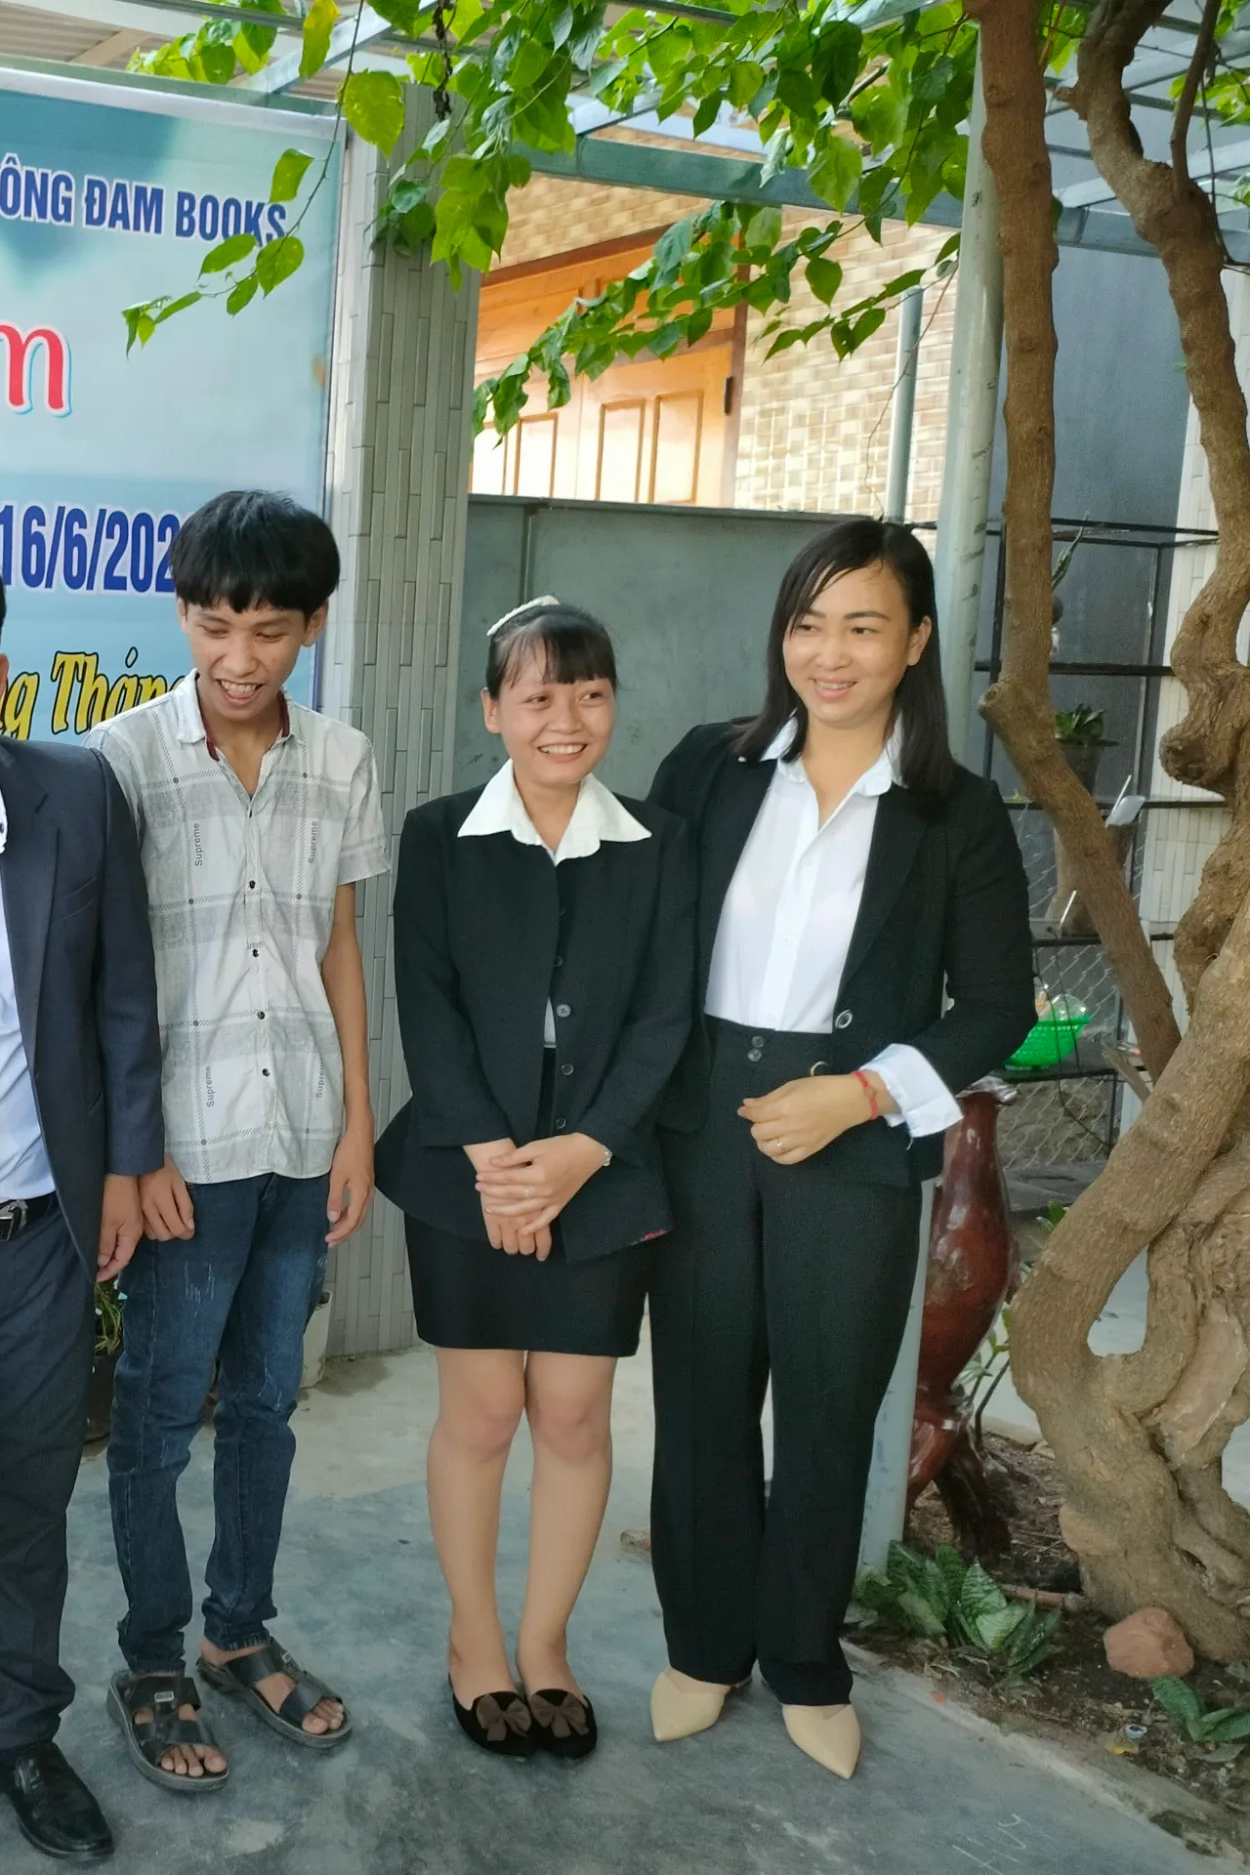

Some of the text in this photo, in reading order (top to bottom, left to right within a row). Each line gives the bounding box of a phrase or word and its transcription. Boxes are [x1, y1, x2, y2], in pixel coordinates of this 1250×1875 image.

[85, 177, 164, 235] ĐAM
[176, 192, 287, 245] BOOKS
[51, 646, 188, 734] Thán
[193, 822, 203, 867] Supreme
[308, 820, 318, 864] Supreme
[205, 1065, 216, 1108] Supreme
[316, 1064, 326, 1098] Supre
